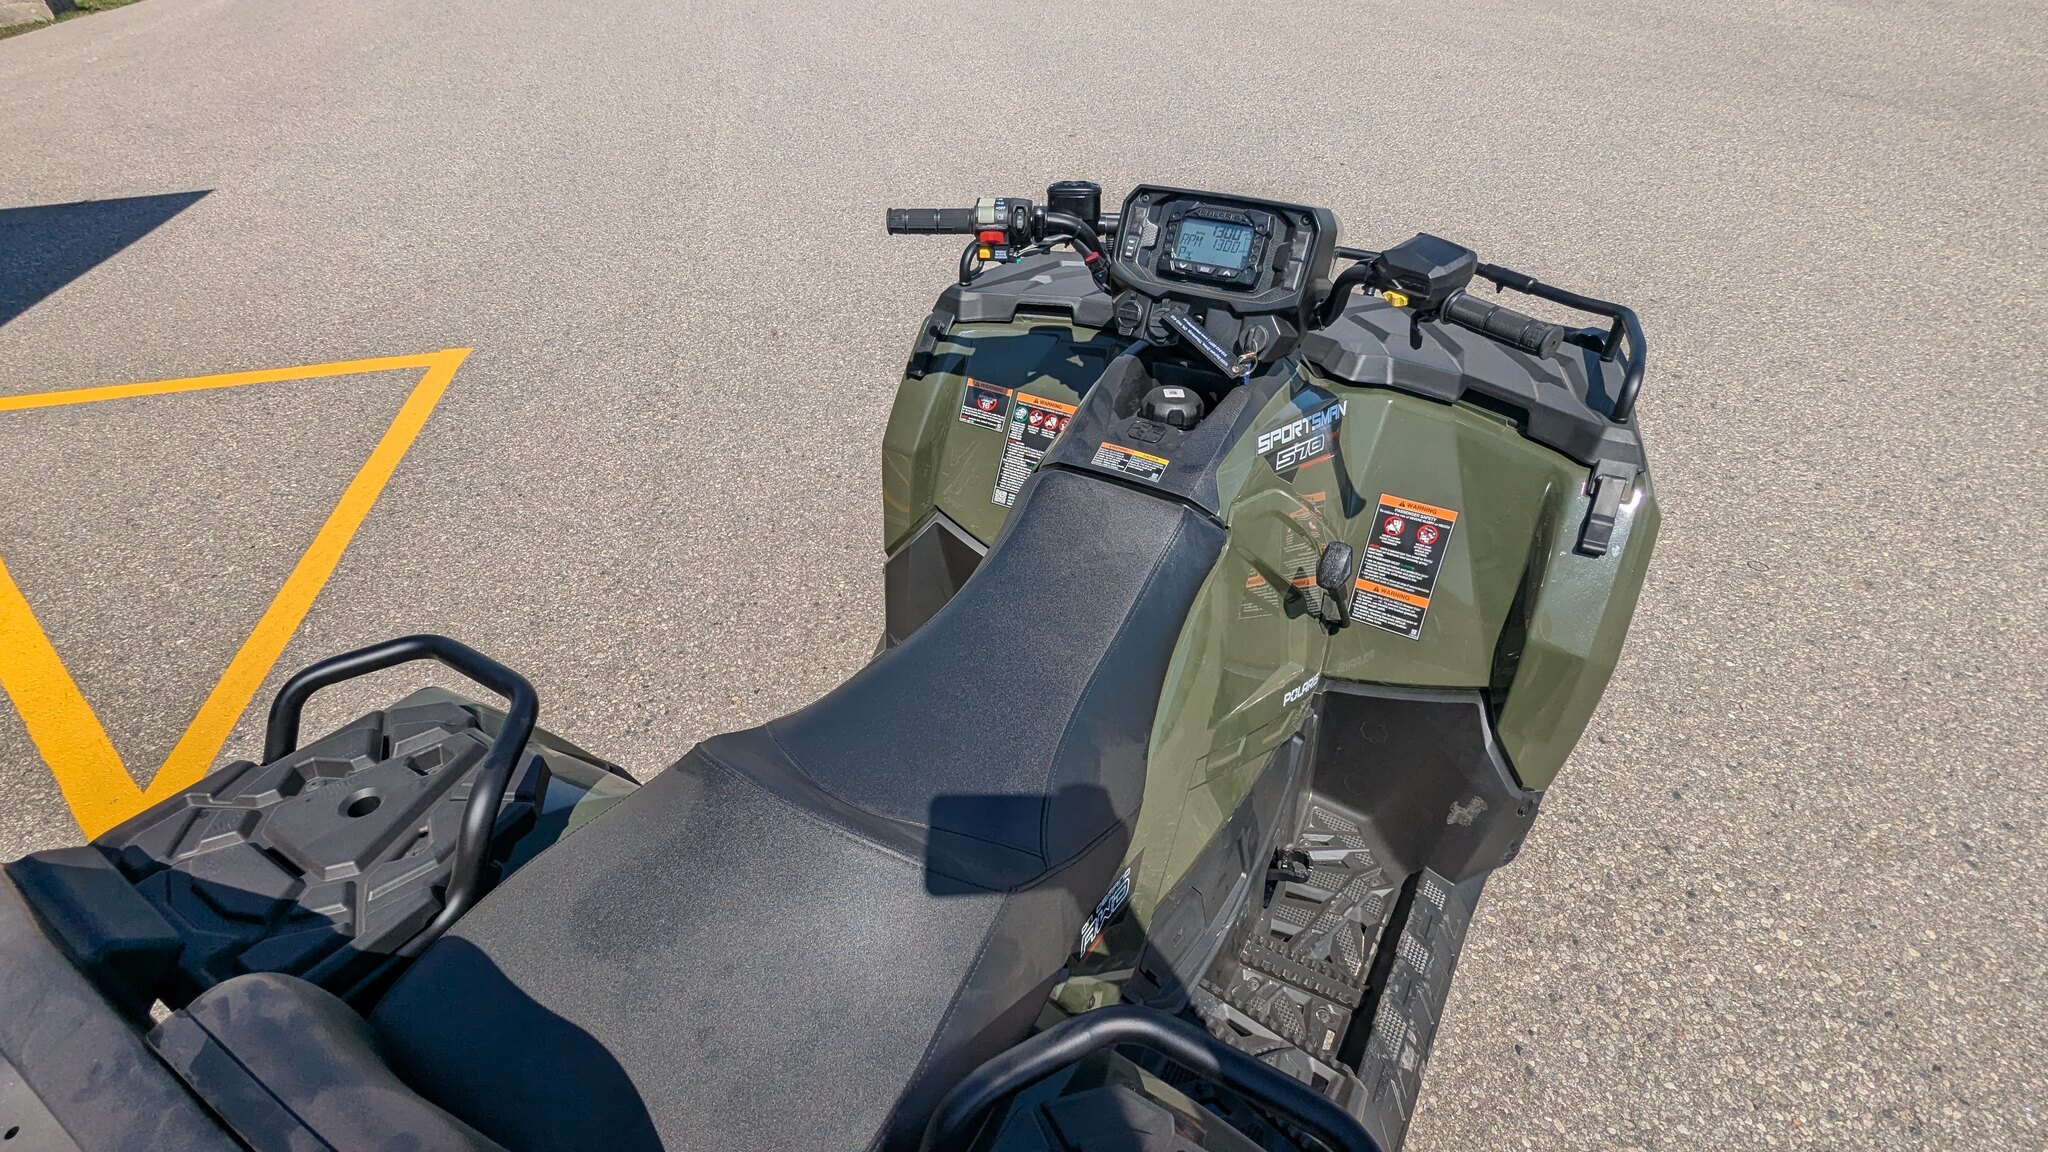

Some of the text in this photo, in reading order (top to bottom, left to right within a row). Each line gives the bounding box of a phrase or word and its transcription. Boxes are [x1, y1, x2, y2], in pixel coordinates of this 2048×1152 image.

[1213, 226, 1242, 240] 1300
[1180, 233, 1204, 247] RPM
[1213, 239, 1241, 253] 1300
[1039, 400, 1063, 410] WARNING
[1257, 400, 1347, 455] SPORTSMAN
[1276, 434, 1325, 471] 570
[1407, 501, 1437, 515] WARNING
[1381, 588, 1410, 601] WARNING
[1283, 672, 1320, 707] POLARIS
